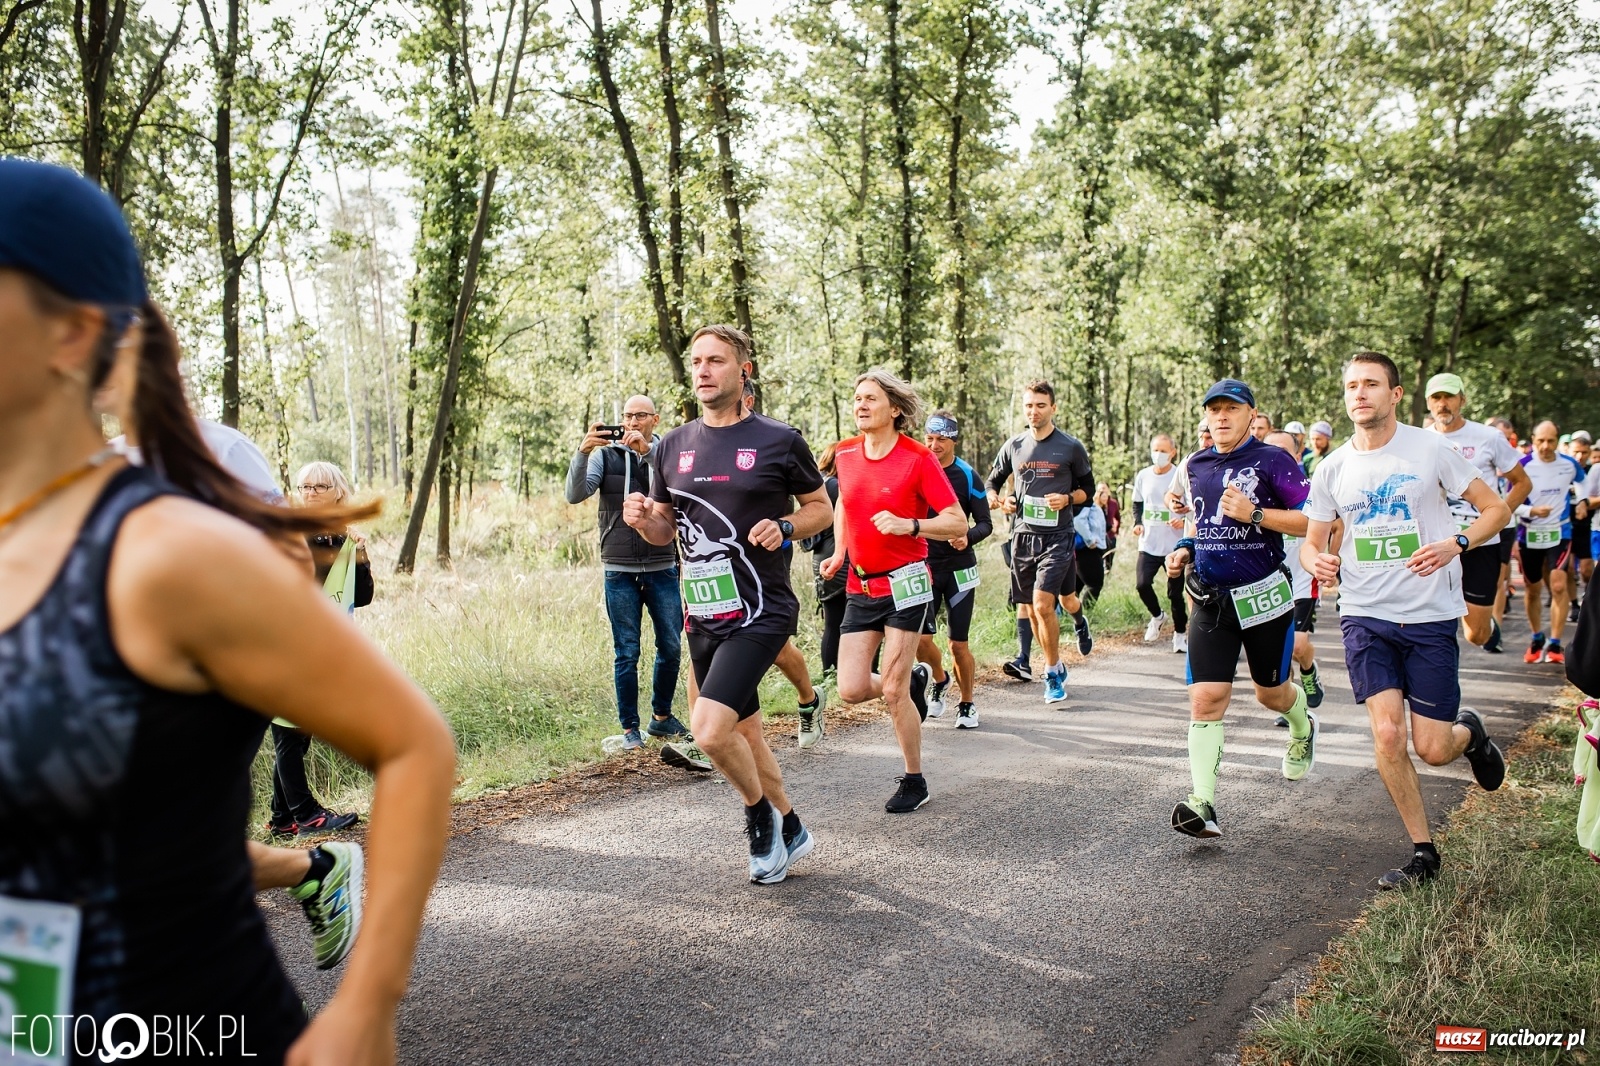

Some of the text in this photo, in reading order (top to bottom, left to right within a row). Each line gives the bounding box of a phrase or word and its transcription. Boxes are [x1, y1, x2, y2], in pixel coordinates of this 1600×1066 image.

[1033, 506, 1046, 518] 13
[1150, 511, 1162, 520] 22
[1535, 532, 1551, 541] 33
[1369, 538, 1402, 560] 76
[963, 566, 979, 581] 10
[690, 579, 721, 602] 101
[902, 574, 928, 596] 167
[1247, 587, 1283, 614] 166
